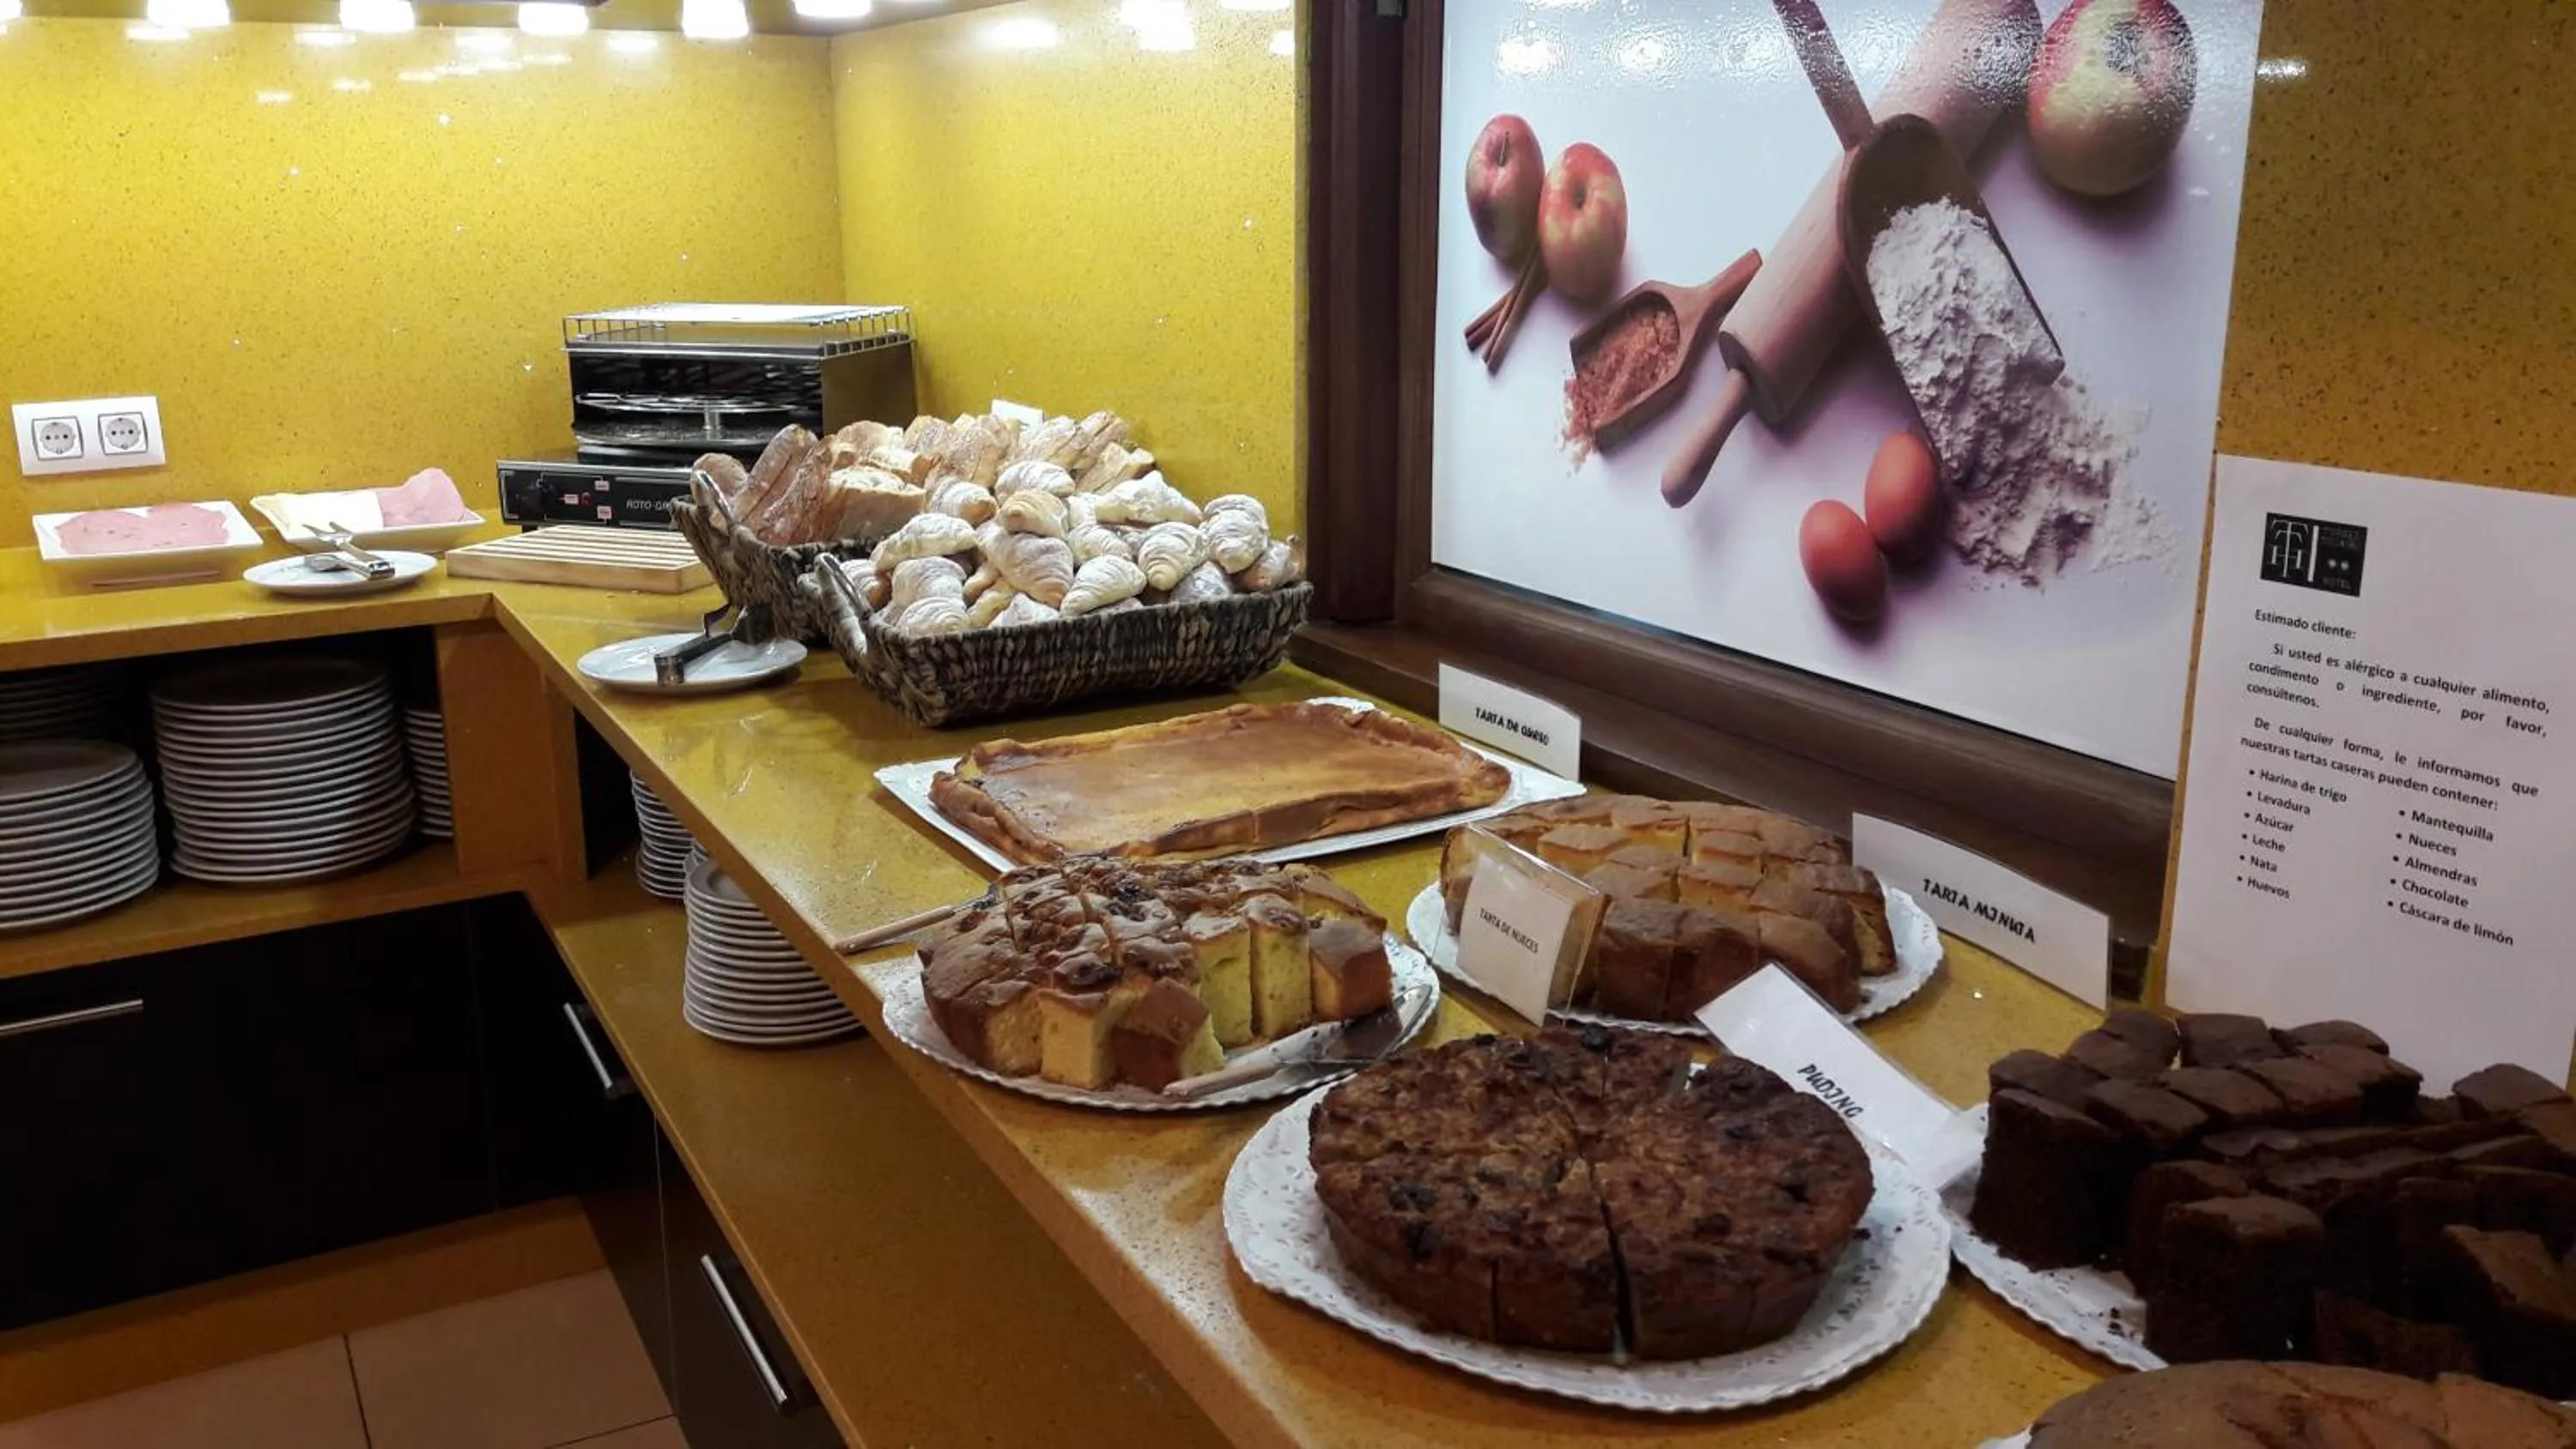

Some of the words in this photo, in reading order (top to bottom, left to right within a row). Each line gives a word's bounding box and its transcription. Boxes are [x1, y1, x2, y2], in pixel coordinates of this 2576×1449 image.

[2255, 609, 2309, 630] Estimado
[2311, 621, 2357, 640] cliente:
[2273, 643, 2284, 656] Si
[2287, 648, 2322, 664] usted
[2326, 657, 2340, 667] es
[2344, 659, 2395, 679] alérgico
[2400, 672, 2408, 682] a
[2414, 675, 2476, 697] cualquier
[2482, 688, 2549, 714] alimento,
[2248, 662, 2319, 686] condimento
[2336, 681, 2345, 691] o
[2362, 684, 2441, 714] ingrediente,
[2460, 708, 2485, 722] por
[2506, 716, 2547, 738] favor,
[1476, 706, 1504, 728] TARTA
[2254, 717, 2270, 730] De
[2279, 724, 2334, 746] cualquier
[2343, 738, 2384, 761] forma,
[2395, 751, 2407, 765] le
[2417, 757, 2500, 787] informamos
[2512, 782, 2539, 797] que
[2240, 737, 2290, 757] nuestras
[2293, 749, 2328, 767] tartas
[2331, 760, 2375, 780] caseras
[2378, 773, 2428, 793] pueden
[2432, 786, 2498, 810] contener:
[2259, 769, 2298, 788] Harina
[2301, 781, 2316, 793] de
[2319, 786, 2347, 803] trigo
[2257, 791, 2311, 815] Levadura
[2255, 812, 2294, 833] Azúcar
[2411, 810, 2494, 842] Mantequilla
[2252, 834, 2286, 852] Leche
[2408, 833, 2457, 857] Nueces
[2250, 855, 2278, 873] Nata
[2405, 856, 2478, 887] Almendras
[1923, 878, 1970, 911] TARTA
[2247, 876, 2290, 899] Huevos
[2402, 878, 2470, 908] Chocolate
[1479, 906, 1501, 929] TARTA
[1500, 921, 1510, 937] DE
[1511, 930, 1540, 955] NUECES
[2400, 901, 2450, 926] Cáscara
[2453, 918, 2470, 933] de
[2474, 923, 2514, 946] limón
